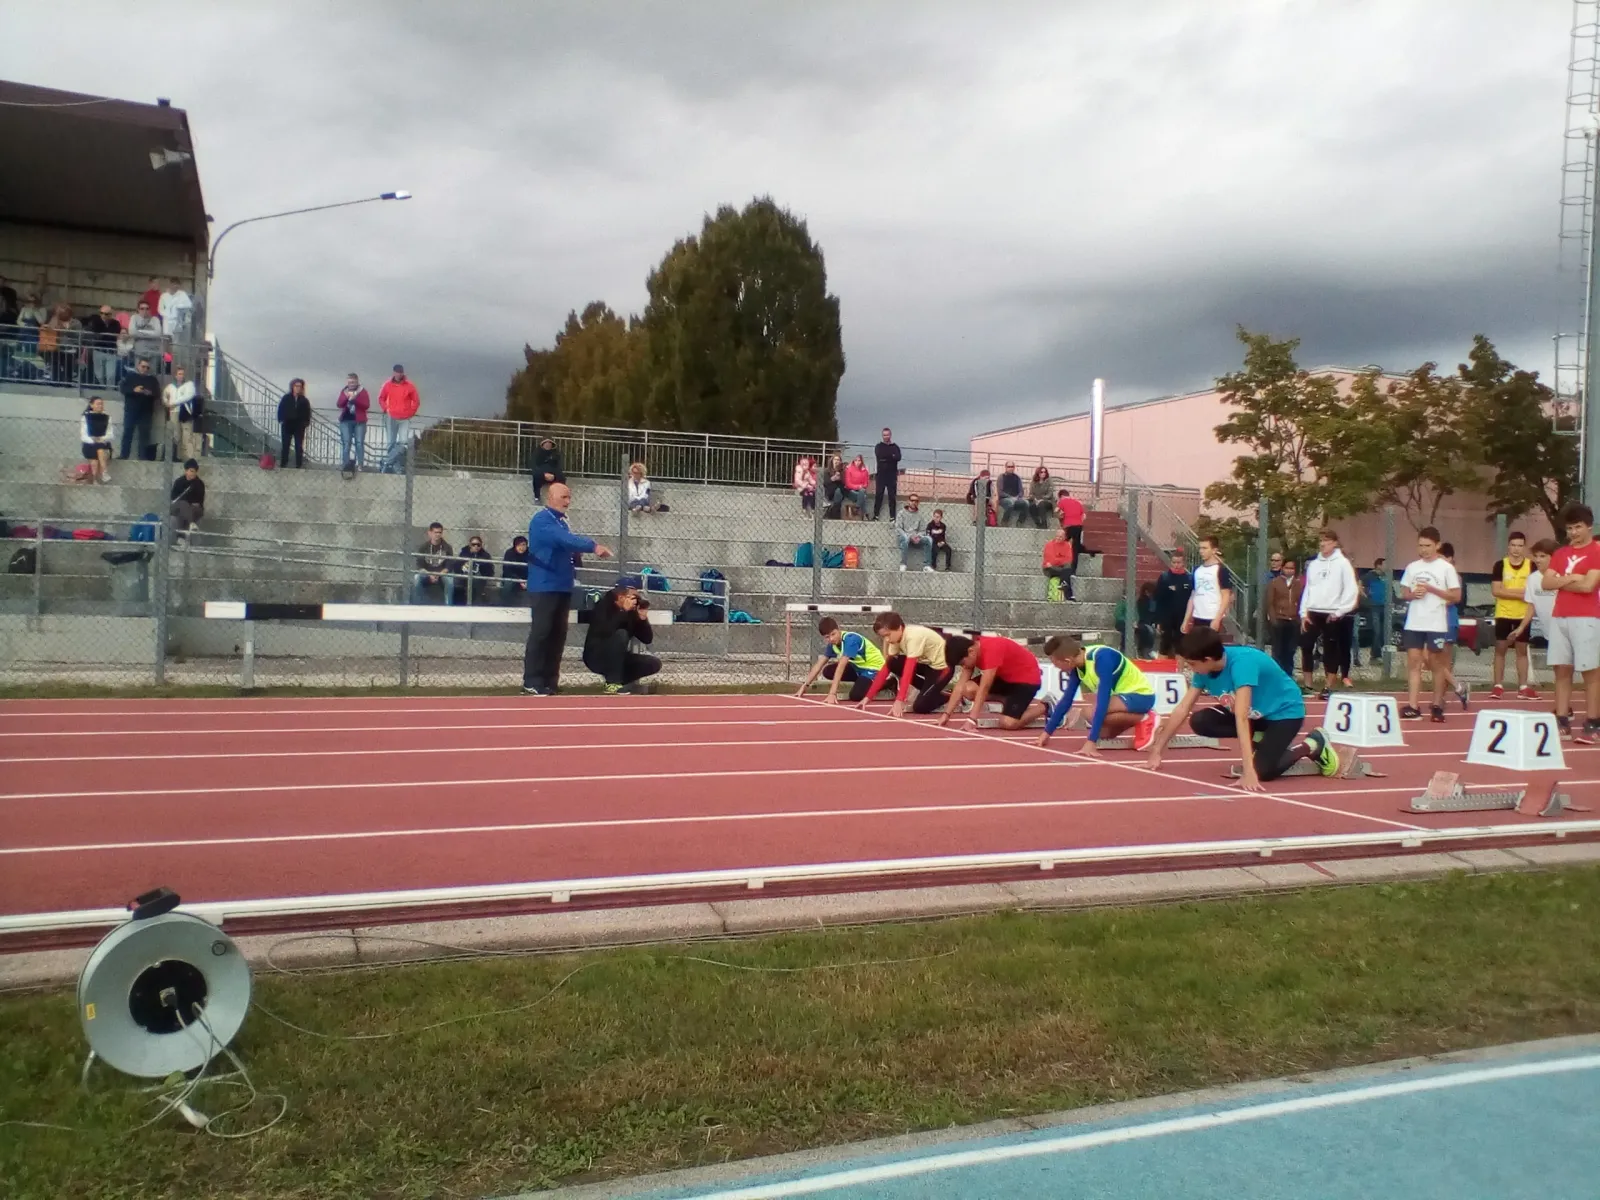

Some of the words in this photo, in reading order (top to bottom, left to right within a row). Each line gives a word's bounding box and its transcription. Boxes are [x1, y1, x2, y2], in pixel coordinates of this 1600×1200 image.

[1165, 679, 1178, 705] 5
[1336, 702, 1352, 732] 3
[1376, 703, 1391, 734] 3
[1487, 719, 1508, 755] 2
[1534, 722, 1551, 757] 2
